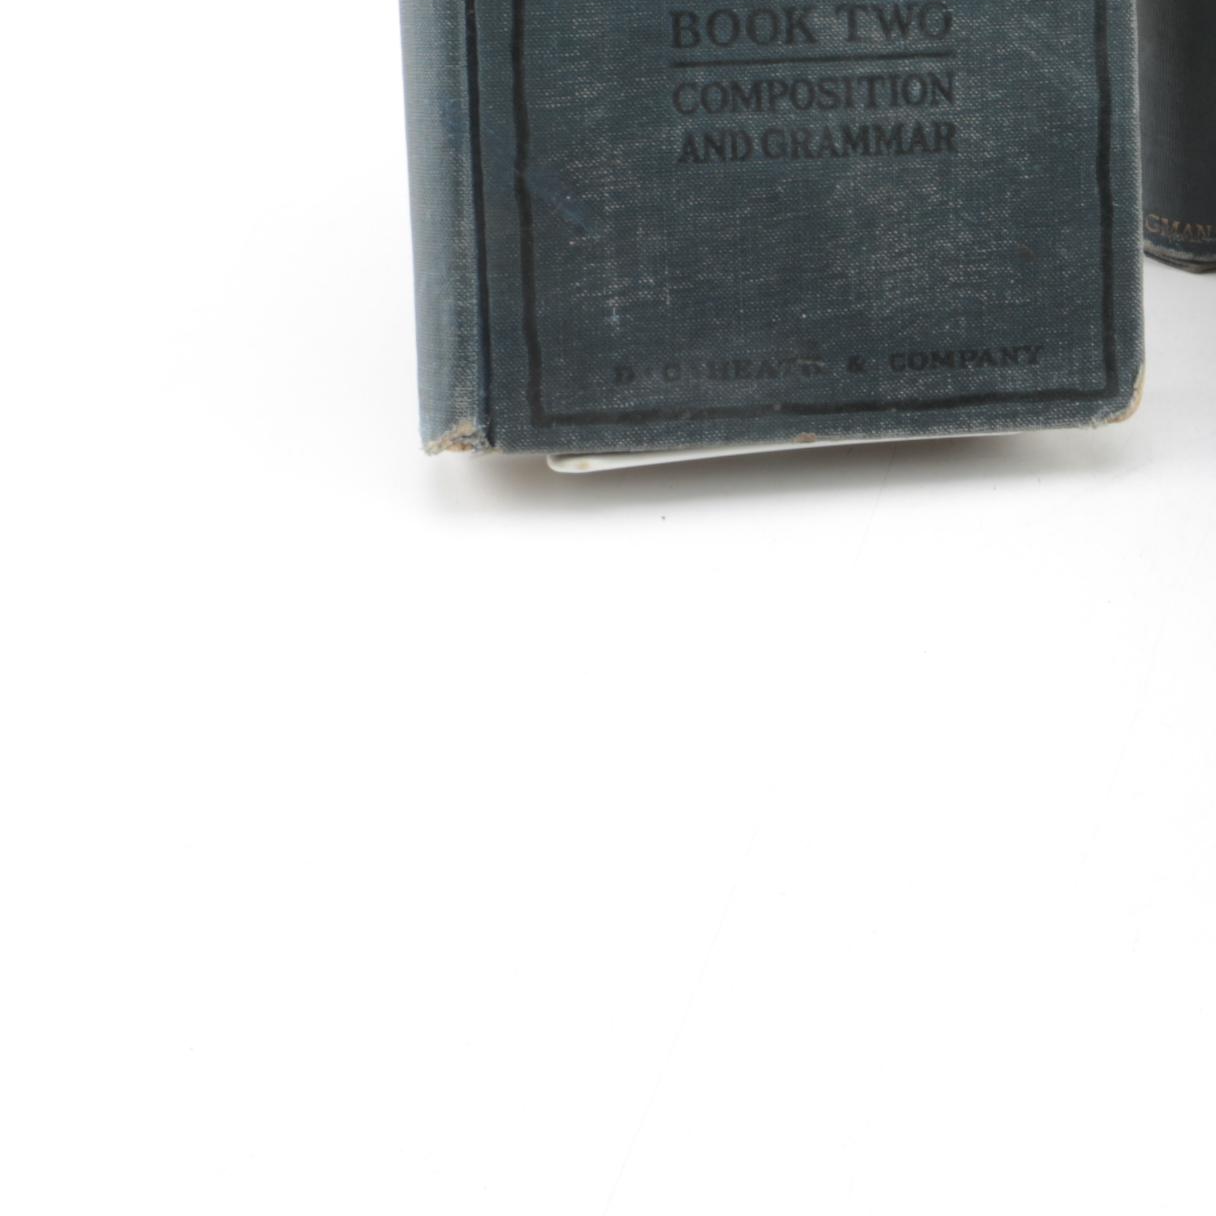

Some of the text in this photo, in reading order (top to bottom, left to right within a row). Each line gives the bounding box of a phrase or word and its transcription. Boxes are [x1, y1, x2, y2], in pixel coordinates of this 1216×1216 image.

[670, 0, 954, 49] BOOK TWO
[672, 72, 955, 116] COMPOSITION
[678, 121, 957, 164] AND GRAMMAR
[847, 355, 864, 373] &
[889, 345, 1045, 372] COMPANY
